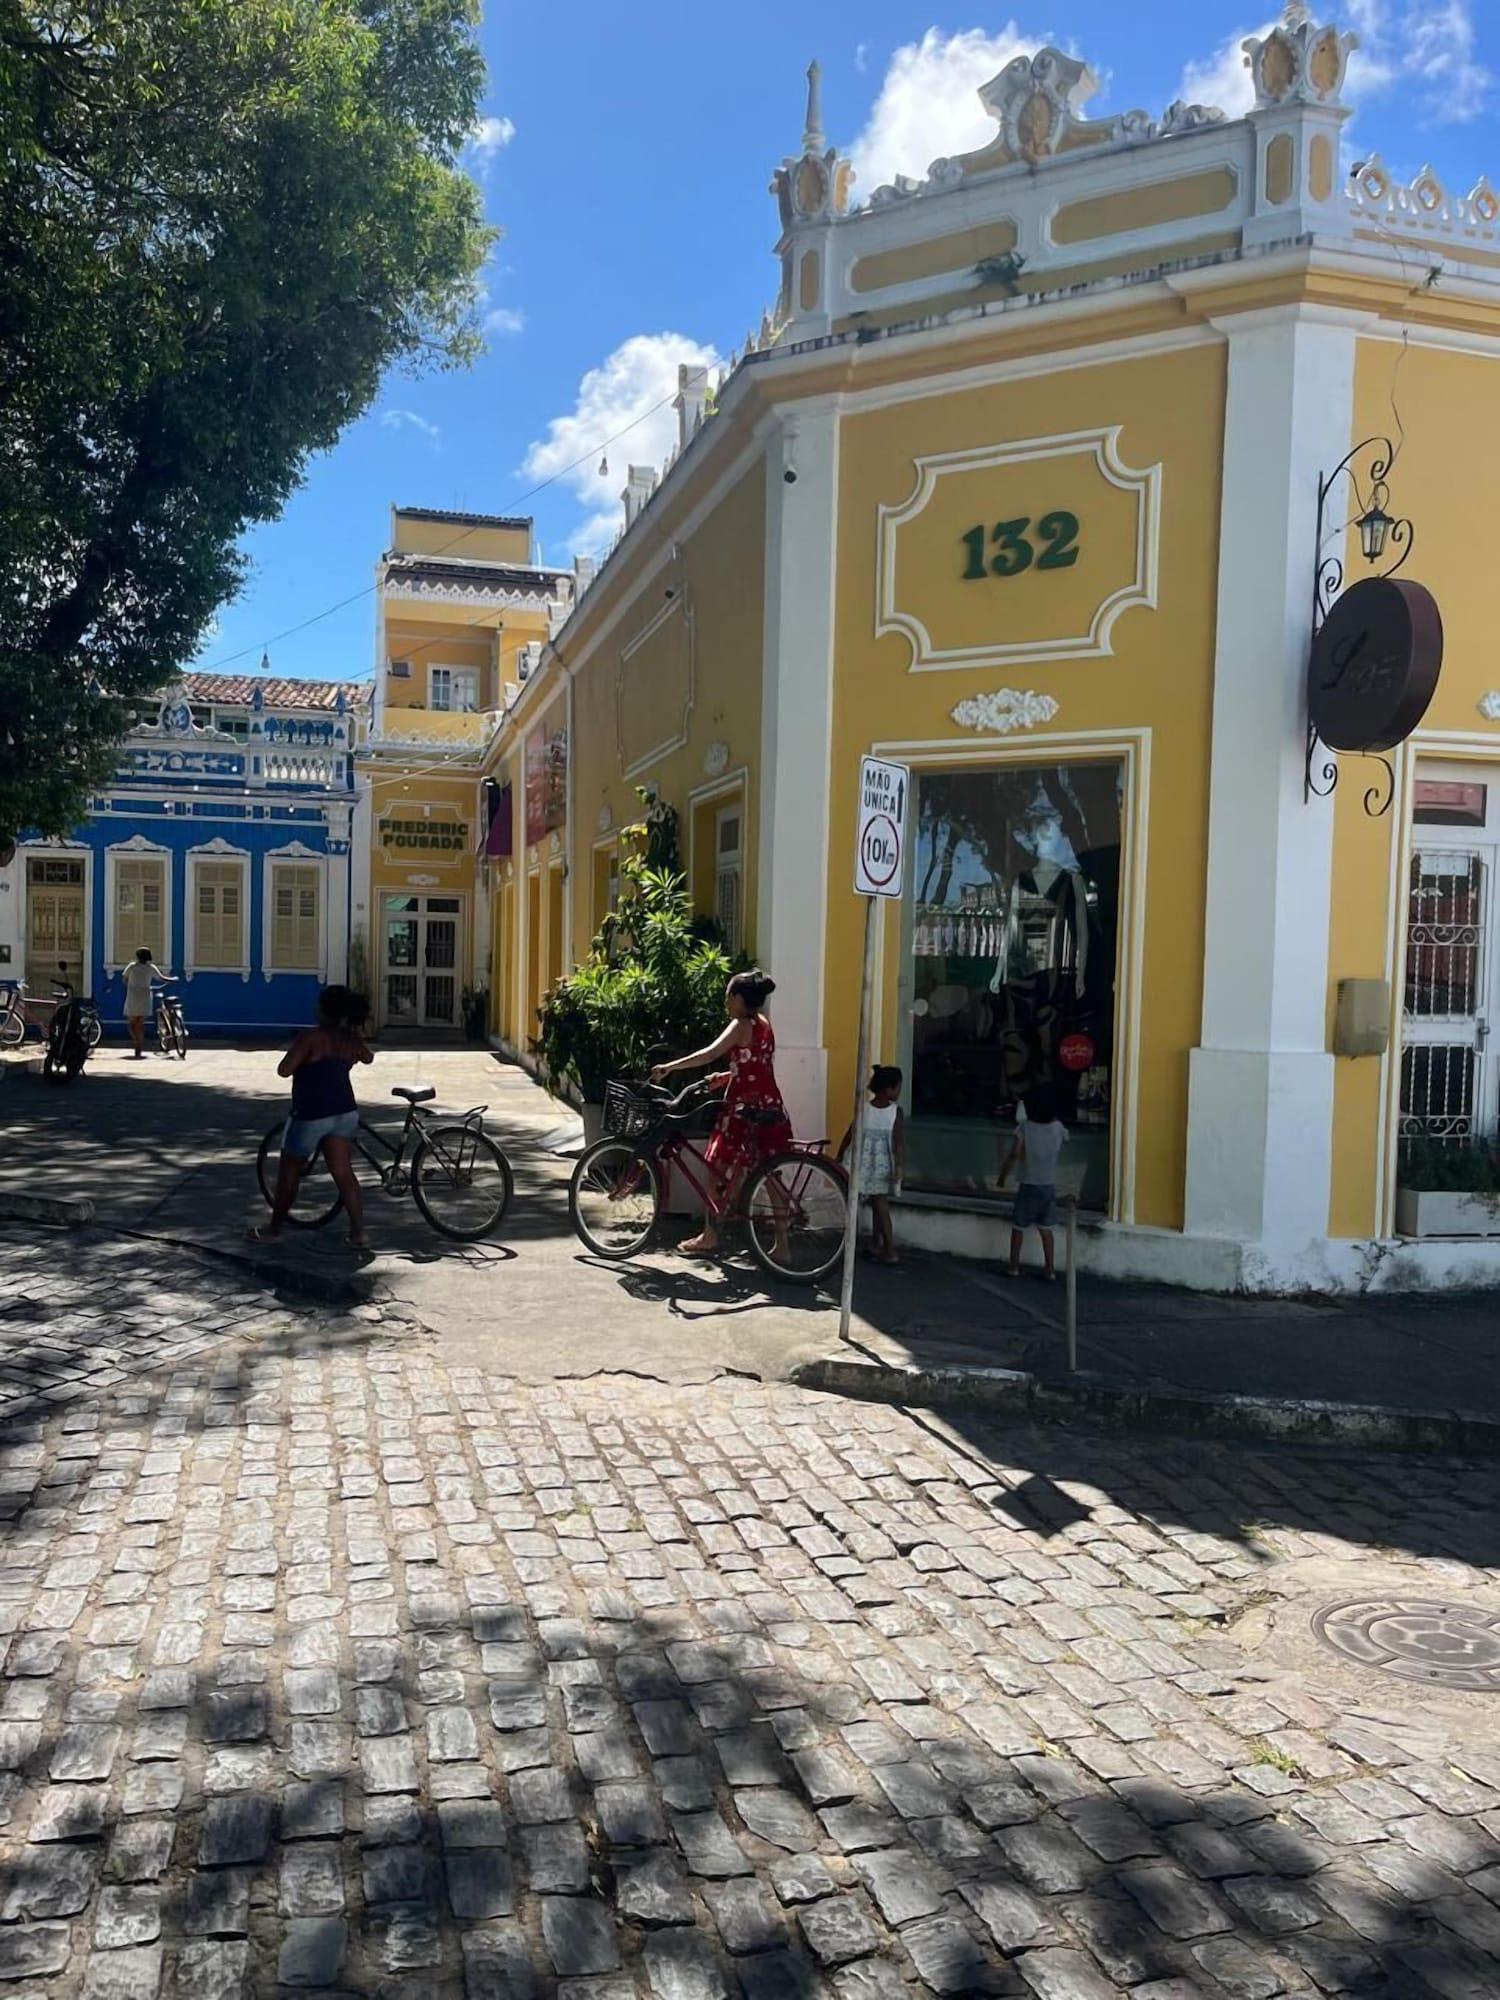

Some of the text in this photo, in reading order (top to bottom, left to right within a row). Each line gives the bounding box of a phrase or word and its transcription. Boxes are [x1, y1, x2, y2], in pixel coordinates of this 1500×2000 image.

[962, 511, 1079, 579] 132
[866, 768, 891, 790] MÃO
[378, 819, 468, 835] FREDERIC
[383, 834, 463, 850] POUSADA
